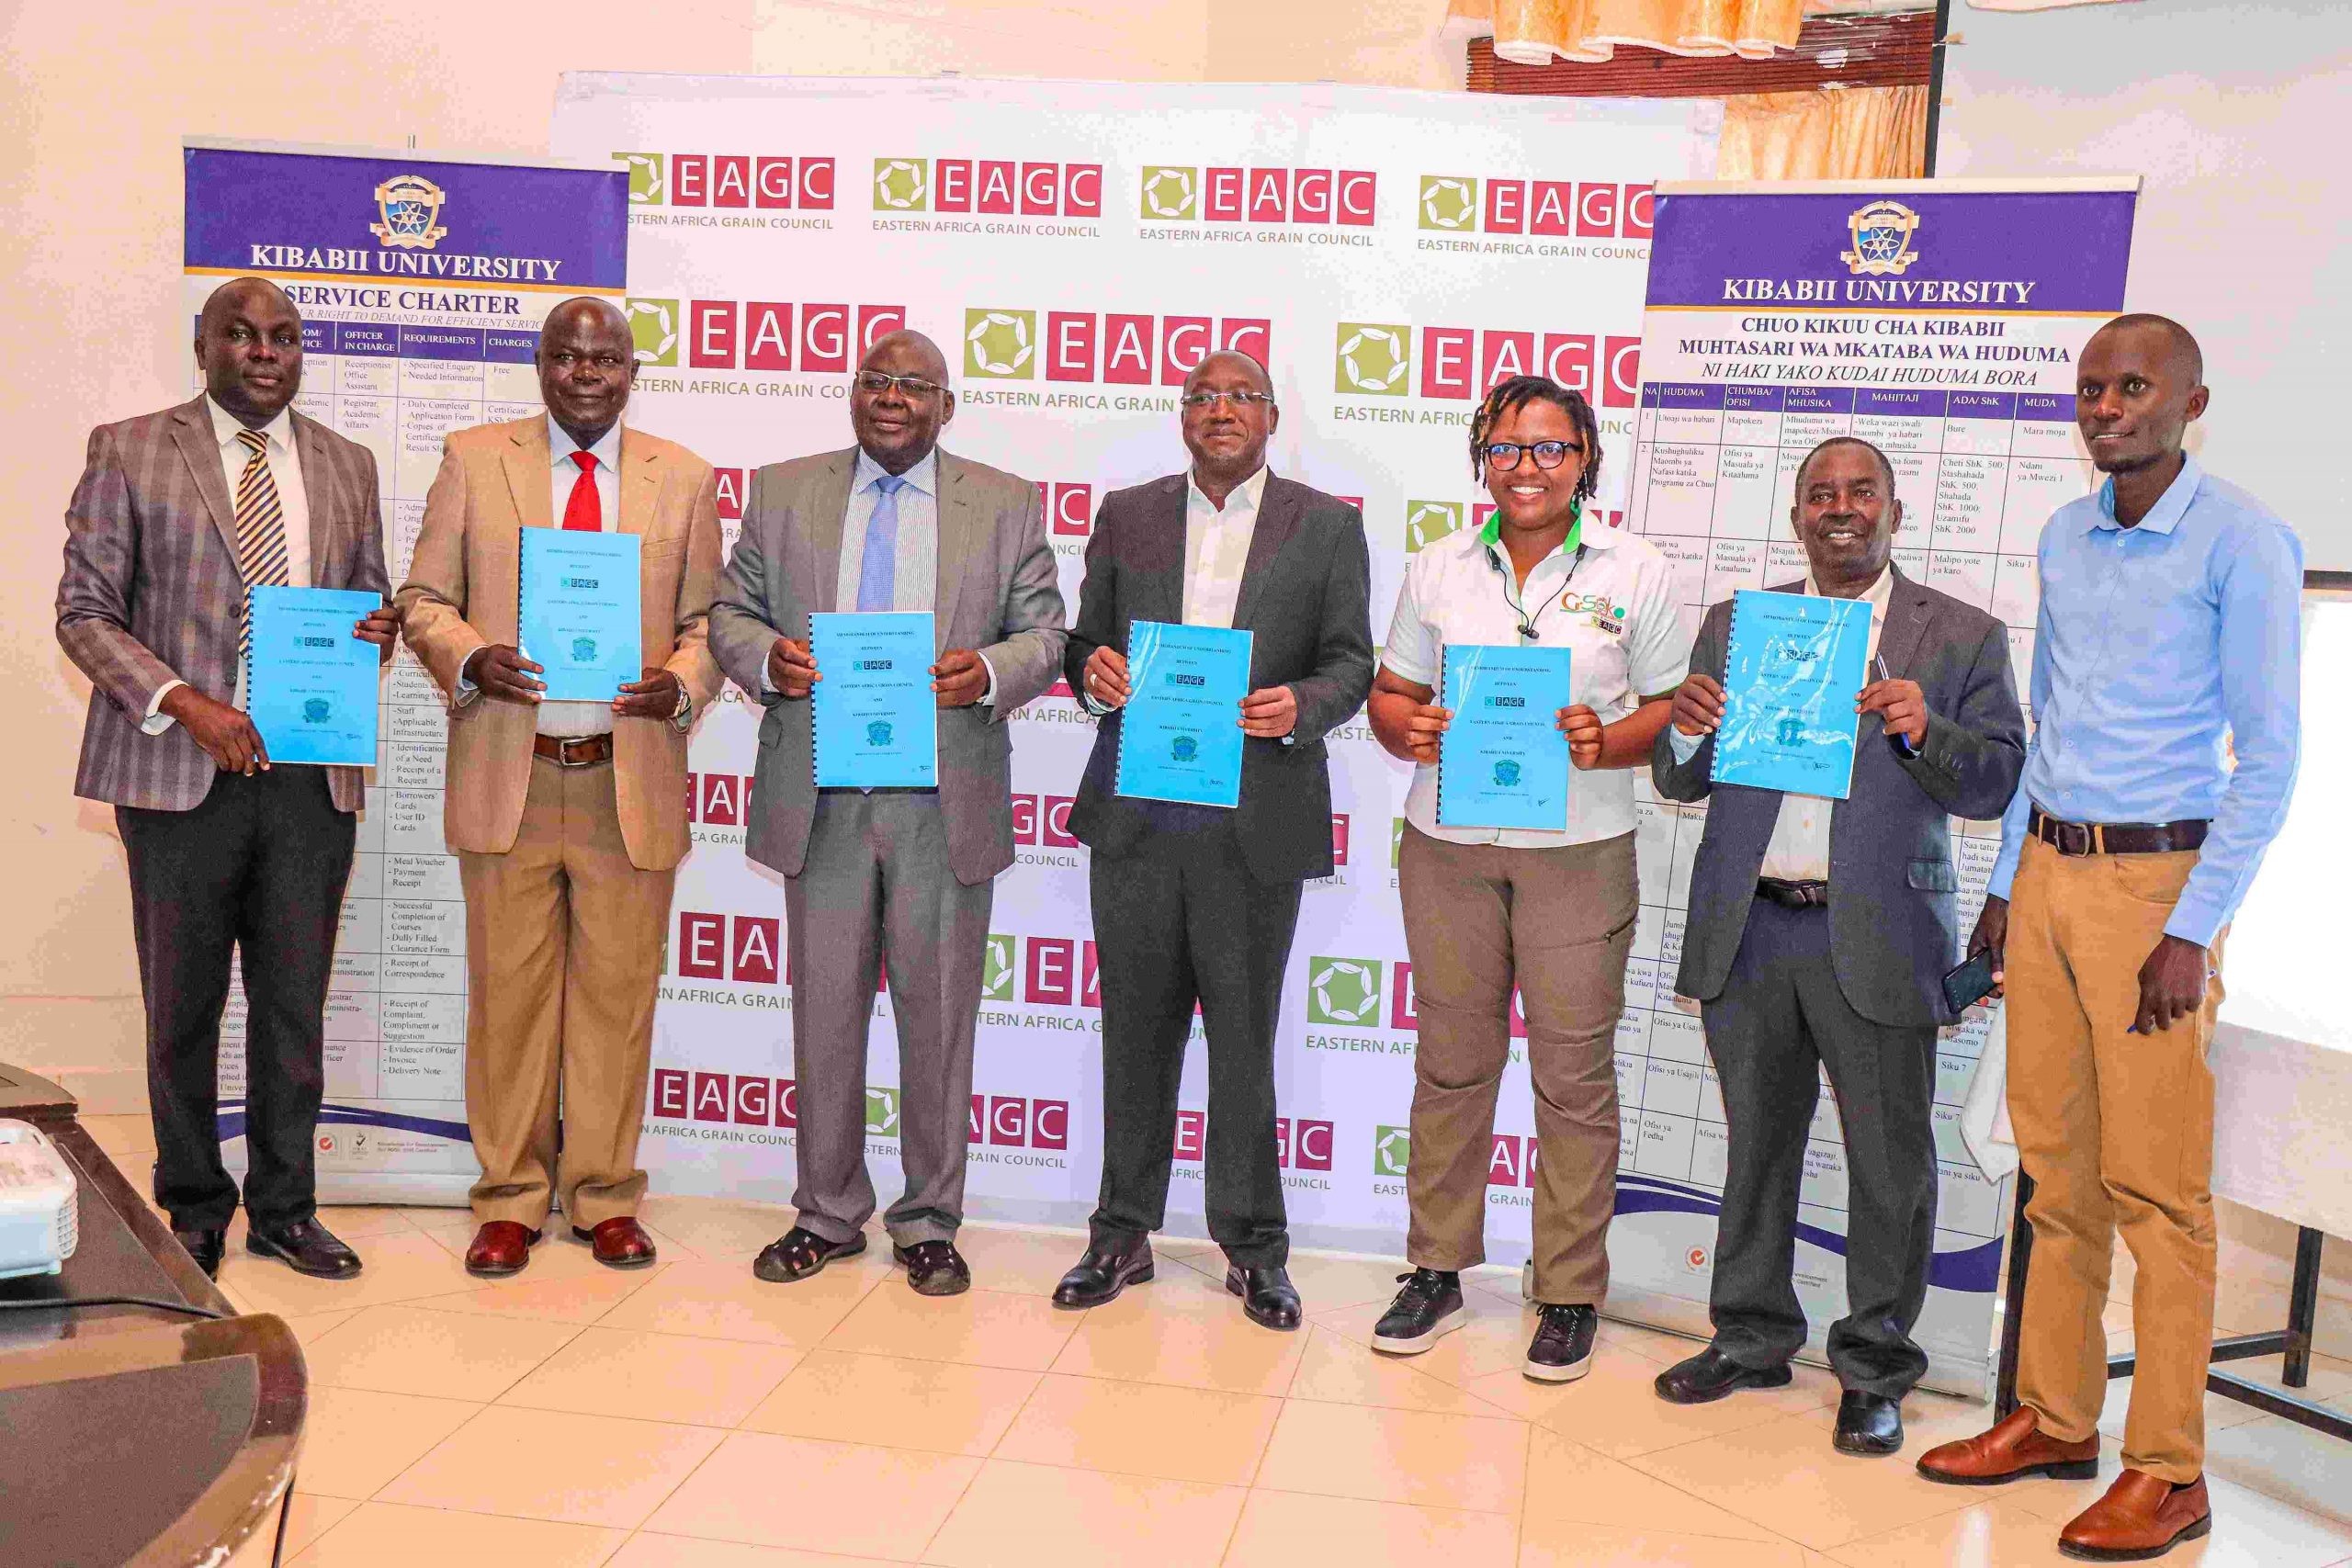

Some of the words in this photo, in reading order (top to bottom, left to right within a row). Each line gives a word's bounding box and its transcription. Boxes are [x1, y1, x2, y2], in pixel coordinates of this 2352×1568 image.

[682, 161, 831, 199] EAGC
[945, 165, 1097, 207] EAGC
[1215, 174, 1371, 216] EAGC
[1495, 186, 1654, 228] EAGC
[628, 213, 668, 225] STERN
[671, 215, 718, 227] AFRICA
[721, 217, 766, 229] GRAIN
[771, 218, 833, 230] COUNCIL
[873, 220, 931, 232] EASTERN
[934, 221, 981, 233] AFRICA
[986, 222, 1031, 235] GRAIN
[1035, 224, 1101, 238] COUNCIL
[1140, 228, 1201, 241] EASTERN
[1204, 230, 1252, 243] AFRICA
[1257, 231, 1304, 244] GRAIN
[1307, 232, 1374, 247] COUNCIL
[1418, 239, 1479, 253] EASTERN
[1483, 242, 1534, 255] AFRICA
[1539, 243, 1587, 257] GRAIN
[1591, 245, 1651, 260] COUNCI
[250, 244, 368, 271] KIBABII
[378, 251, 562, 281] UNIVERSITY
[1723, 278, 1837, 301] KIBABII
[1845, 280, 2035, 304] UNIVERSITY
[284, 285, 391, 308] SERVICE
[399, 292, 520, 314] CHARTER
[318, 309, 352, 321] RIGHT
[371, 312, 418, 323] DEMAND
[421, 315, 443, 324] FOR
[446, 316, 503, 328] EFFICIENT
[504, 319, 543, 329] SERVIC
[1741, 317, 1798, 333] CHUO
[1804, 319, 1870, 334] KIKUU
[1874, 320, 1919, 335] CHA
[1925, 321, 2005, 337] KIBABII
[345, 331, 383, 340] OFFICER
[404, 334, 476, 344] REQUIREMENTS
[356, 343, 395, 352] CHARGE
[489, 338, 532, 348] CHARGES
[1679, 339, 1793, 356] MUHTASARI
[1799, 342, 1828, 356] WA
[1834, 342, 1933, 360] MKATABA
[1938, 345, 1970, 360] WA
[1975, 346, 2070, 363] HUDUMA
[408, 361, 444, 369] Specified
[447, 363, 476, 372] Enquiry
[493, 367, 511, 375] Free
[1436, 336, 1641, 397] EAGC
[408, 372, 437, 380] Needed
[439, 373, 483, 383] Information
[1702, 363, 1722, 378] NI
[1725, 363, 1770, 379] HAKI
[1776, 365, 1823, 379] YAKO
[1826, 366, 1889, 381] KUDAI
[1894, 367, 1980, 384] HUDUMA
[1984, 369, 2038, 386] BORA
[632, 379, 683, 393] STERN
[689, 381, 750, 395] AFRICA
[756, 383, 813, 397] GRAIN
[1727, 388, 1772, 396] CHUMBA/
[1789, 388, 1816, 396] AFISA
[1664, 389, 1704, 397] HUDUMA
[1871, 393, 1919, 402] MAHITAJI
[963, 390, 1040, 407] EASTERN
[1046, 393, 1108, 411] AFRICA
[1115, 395, 1174, 413] GRAIN
[1726, 399, 1750, 407] OFISI
[1788, 399, 1832, 408] MHUSIKA
[1953, 396, 1978, 405] ADA/
[1981, 397, 1999, 406] ShK
[2024, 398, 2056, 407] MUDA
[428, 401, 469, 411] Completed
[411, 412, 453, 422] Application
[1335, 406, 1414, 423] EASTERN
[1727, 417, 1763, 425] Mapokezi
[1784, 427, 1820, 436] mapokezi
[2022, 427, 2044, 435] Mara
[2046, 428, 2066, 436] moja
[1655, 446, 1704, 457] Kushughulikia
[1724, 449, 1743, 457] Ofisi
[1654, 457, 1681, 467] Maombi
[1724, 460, 1754, 468] Masuala
[2019, 461, 2042, 469] Ndani
[1722, 470, 1758, 479] Kitaaluma
[1941, 470, 1984, 479] Stashahada
[2029, 474, 2057, 482] Mwezi
[1651, 479, 1685, 488] Programu
[1939, 492, 1971, 501] Shahada
[1936, 514, 1970, 523] Uzamifu
[1682, 552, 1703, 560] katika
[1715, 553, 1746, 562] Masuala
[1934, 555, 1962, 564] Malipo
[1714, 564, 1751, 573] Kitaaluma
[864, 660, 892, 670] EAGC
[1177, 674, 1204, 685] EAGC
[1496, 697, 1525, 706] EAGC
[393, 729, 444, 738] Infrastructure
[397, 744, 447, 752] Identification
[397, 766, 424, 775] Receipt
[397, 776, 427, 785] Request
[394, 802, 416, 810] Cards
[415, 858, 446, 866] Voucher
[1015, 854, 1079, 867] COUNCIL
[393, 868, 426, 877] Payment
[392, 879, 421, 887] Receipt
[391, 913, 435, 921] Completion
[391, 923, 422, 931] Courses
[391, 934, 413, 942] Dully
[415, 934, 437, 942] Filled
[390, 959, 419, 967] Receipt
[384, 970, 445, 979] Correspondence
[678, 988, 737, 1005] AFRICA
[390, 1000, 417, 1009] Receipt
[383, 1021, 429, 1031] Compliment
[978, 1012, 1019, 1026] TERN
[1024, 1015, 1085, 1032] AFRICA
[1654, 1018, 1671, 1026] Ofisi
[383, 1032, 424, 1041] Suggestion
[1306, 1036, 1385, 1054] EASTERN
[389, 1045, 422, 1054] Evidence
[435, 1046, 457, 1055] Order
[389, 1067, 420, 1076] Delivery
[424, 1067, 441, 1076] Note
[1648, 1064, 1665, 1073] Ofisi
[969, 1103, 1064, 1140] AGC
[1644, 1120, 1661, 1129] Ofisi
[652, 1126, 696, 1138] AFRICA
[702, 1130, 743, 1142] GRAIN
[1643, 1131, 1664, 1141] Fedha
[1697, 1130, 1717, 1139] Afisa
[967, 1153, 1000, 1163] RAIN
[1004, 1156, 1067, 1168] COUNCIL
